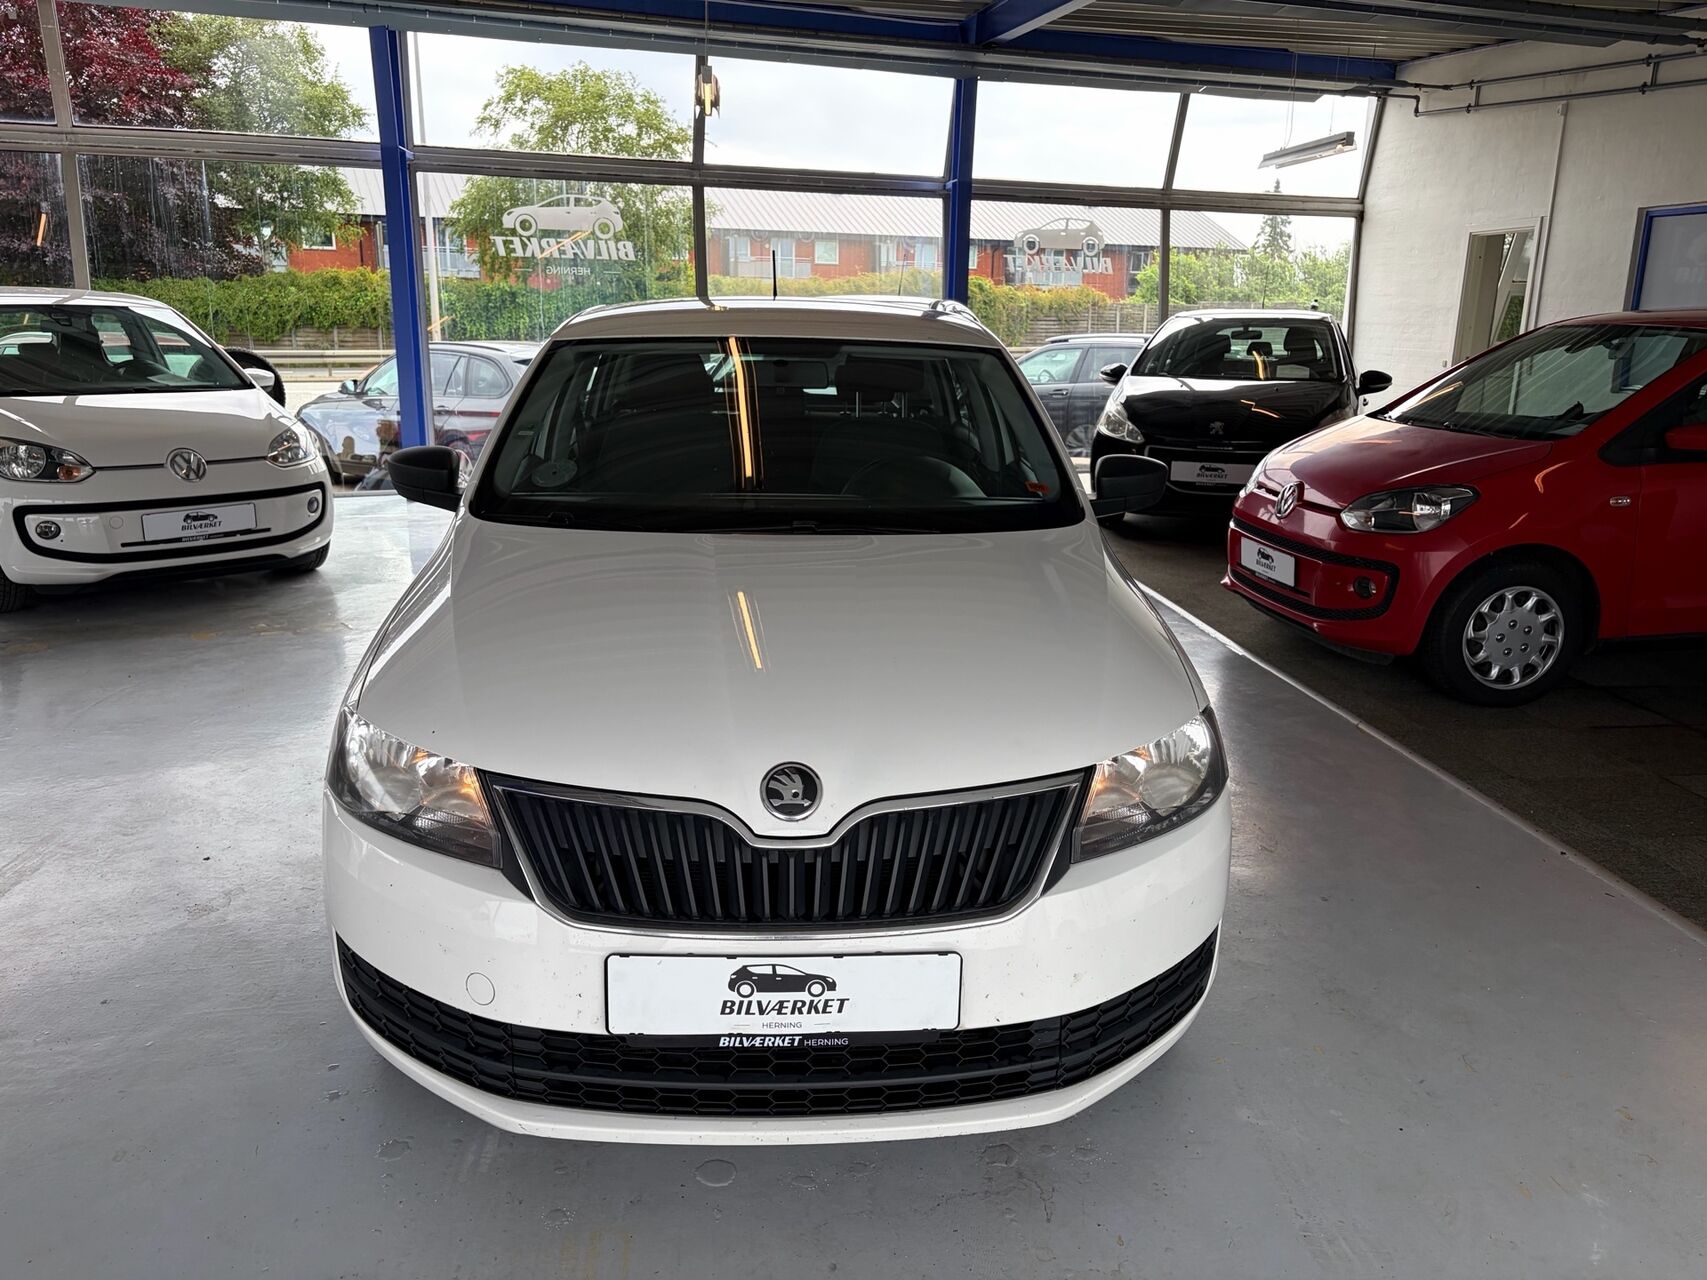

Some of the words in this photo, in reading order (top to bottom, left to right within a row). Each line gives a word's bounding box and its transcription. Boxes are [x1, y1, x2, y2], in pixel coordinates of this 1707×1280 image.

[181, 521, 223, 532] BILVÆRKET
[719, 998, 850, 1016] BILVÆRKET
[762, 1020, 803, 1030] HERNING
[718, 1035, 802, 1048] BILVÆRKET
[804, 1036, 849, 1047] HERNING
